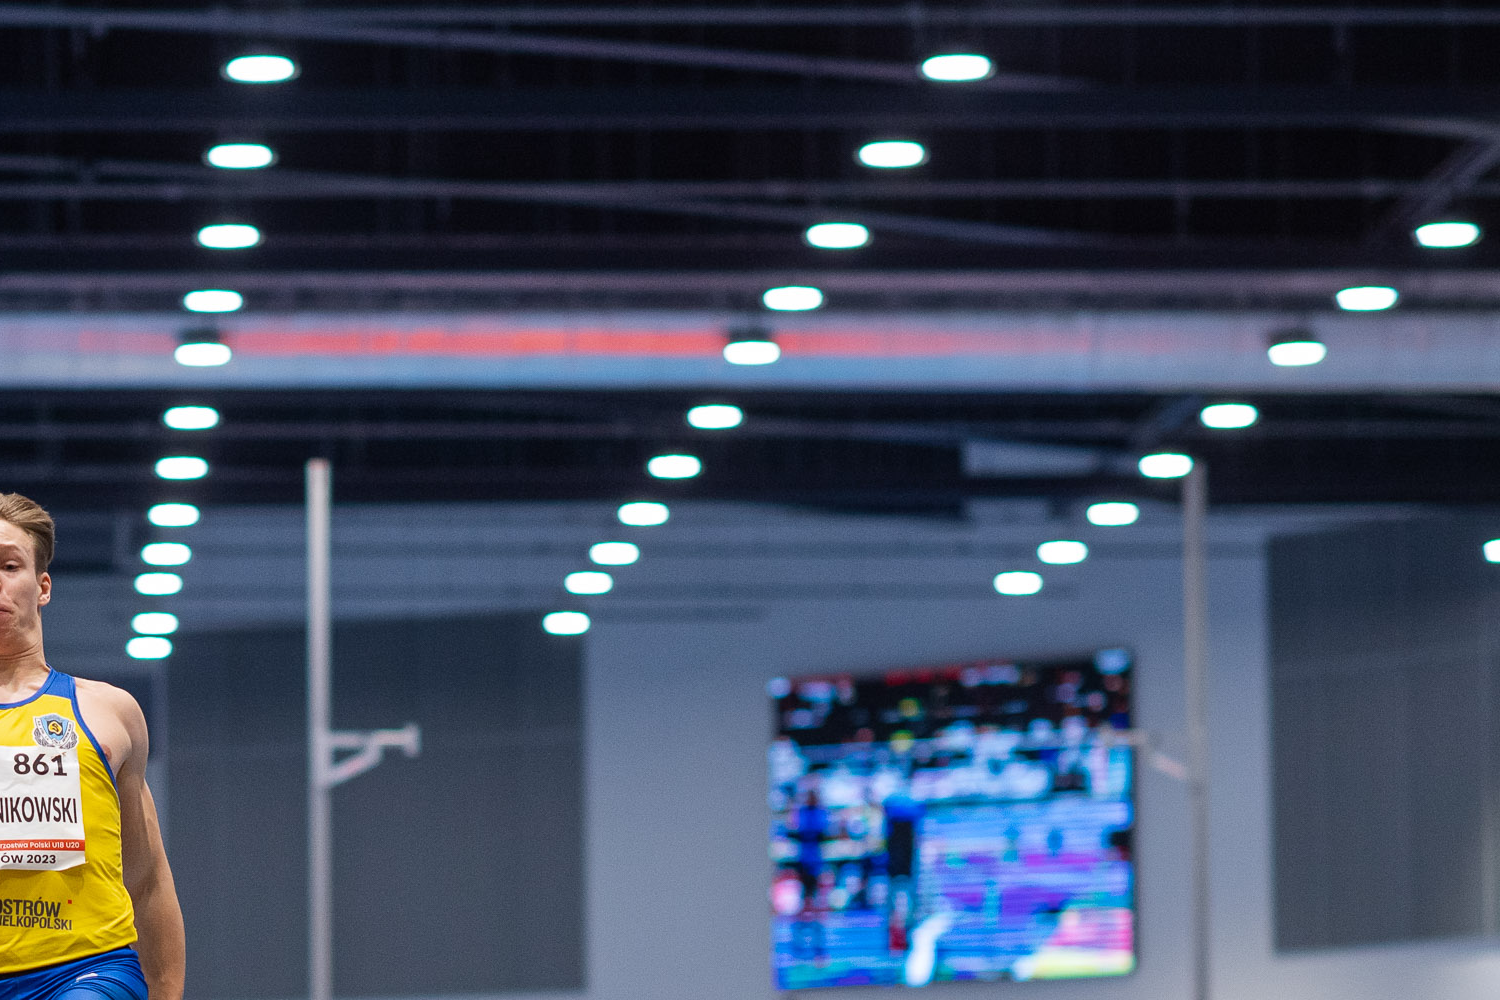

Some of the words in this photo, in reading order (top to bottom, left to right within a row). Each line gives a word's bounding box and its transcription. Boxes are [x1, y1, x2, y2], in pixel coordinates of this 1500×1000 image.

[13, 753, 68, 777] 861
[29, 841, 51, 849] Polski
[51, 841, 65, 849] U18
[65, 841, 80, 849] U20
[26, 854, 57, 864] 2023
